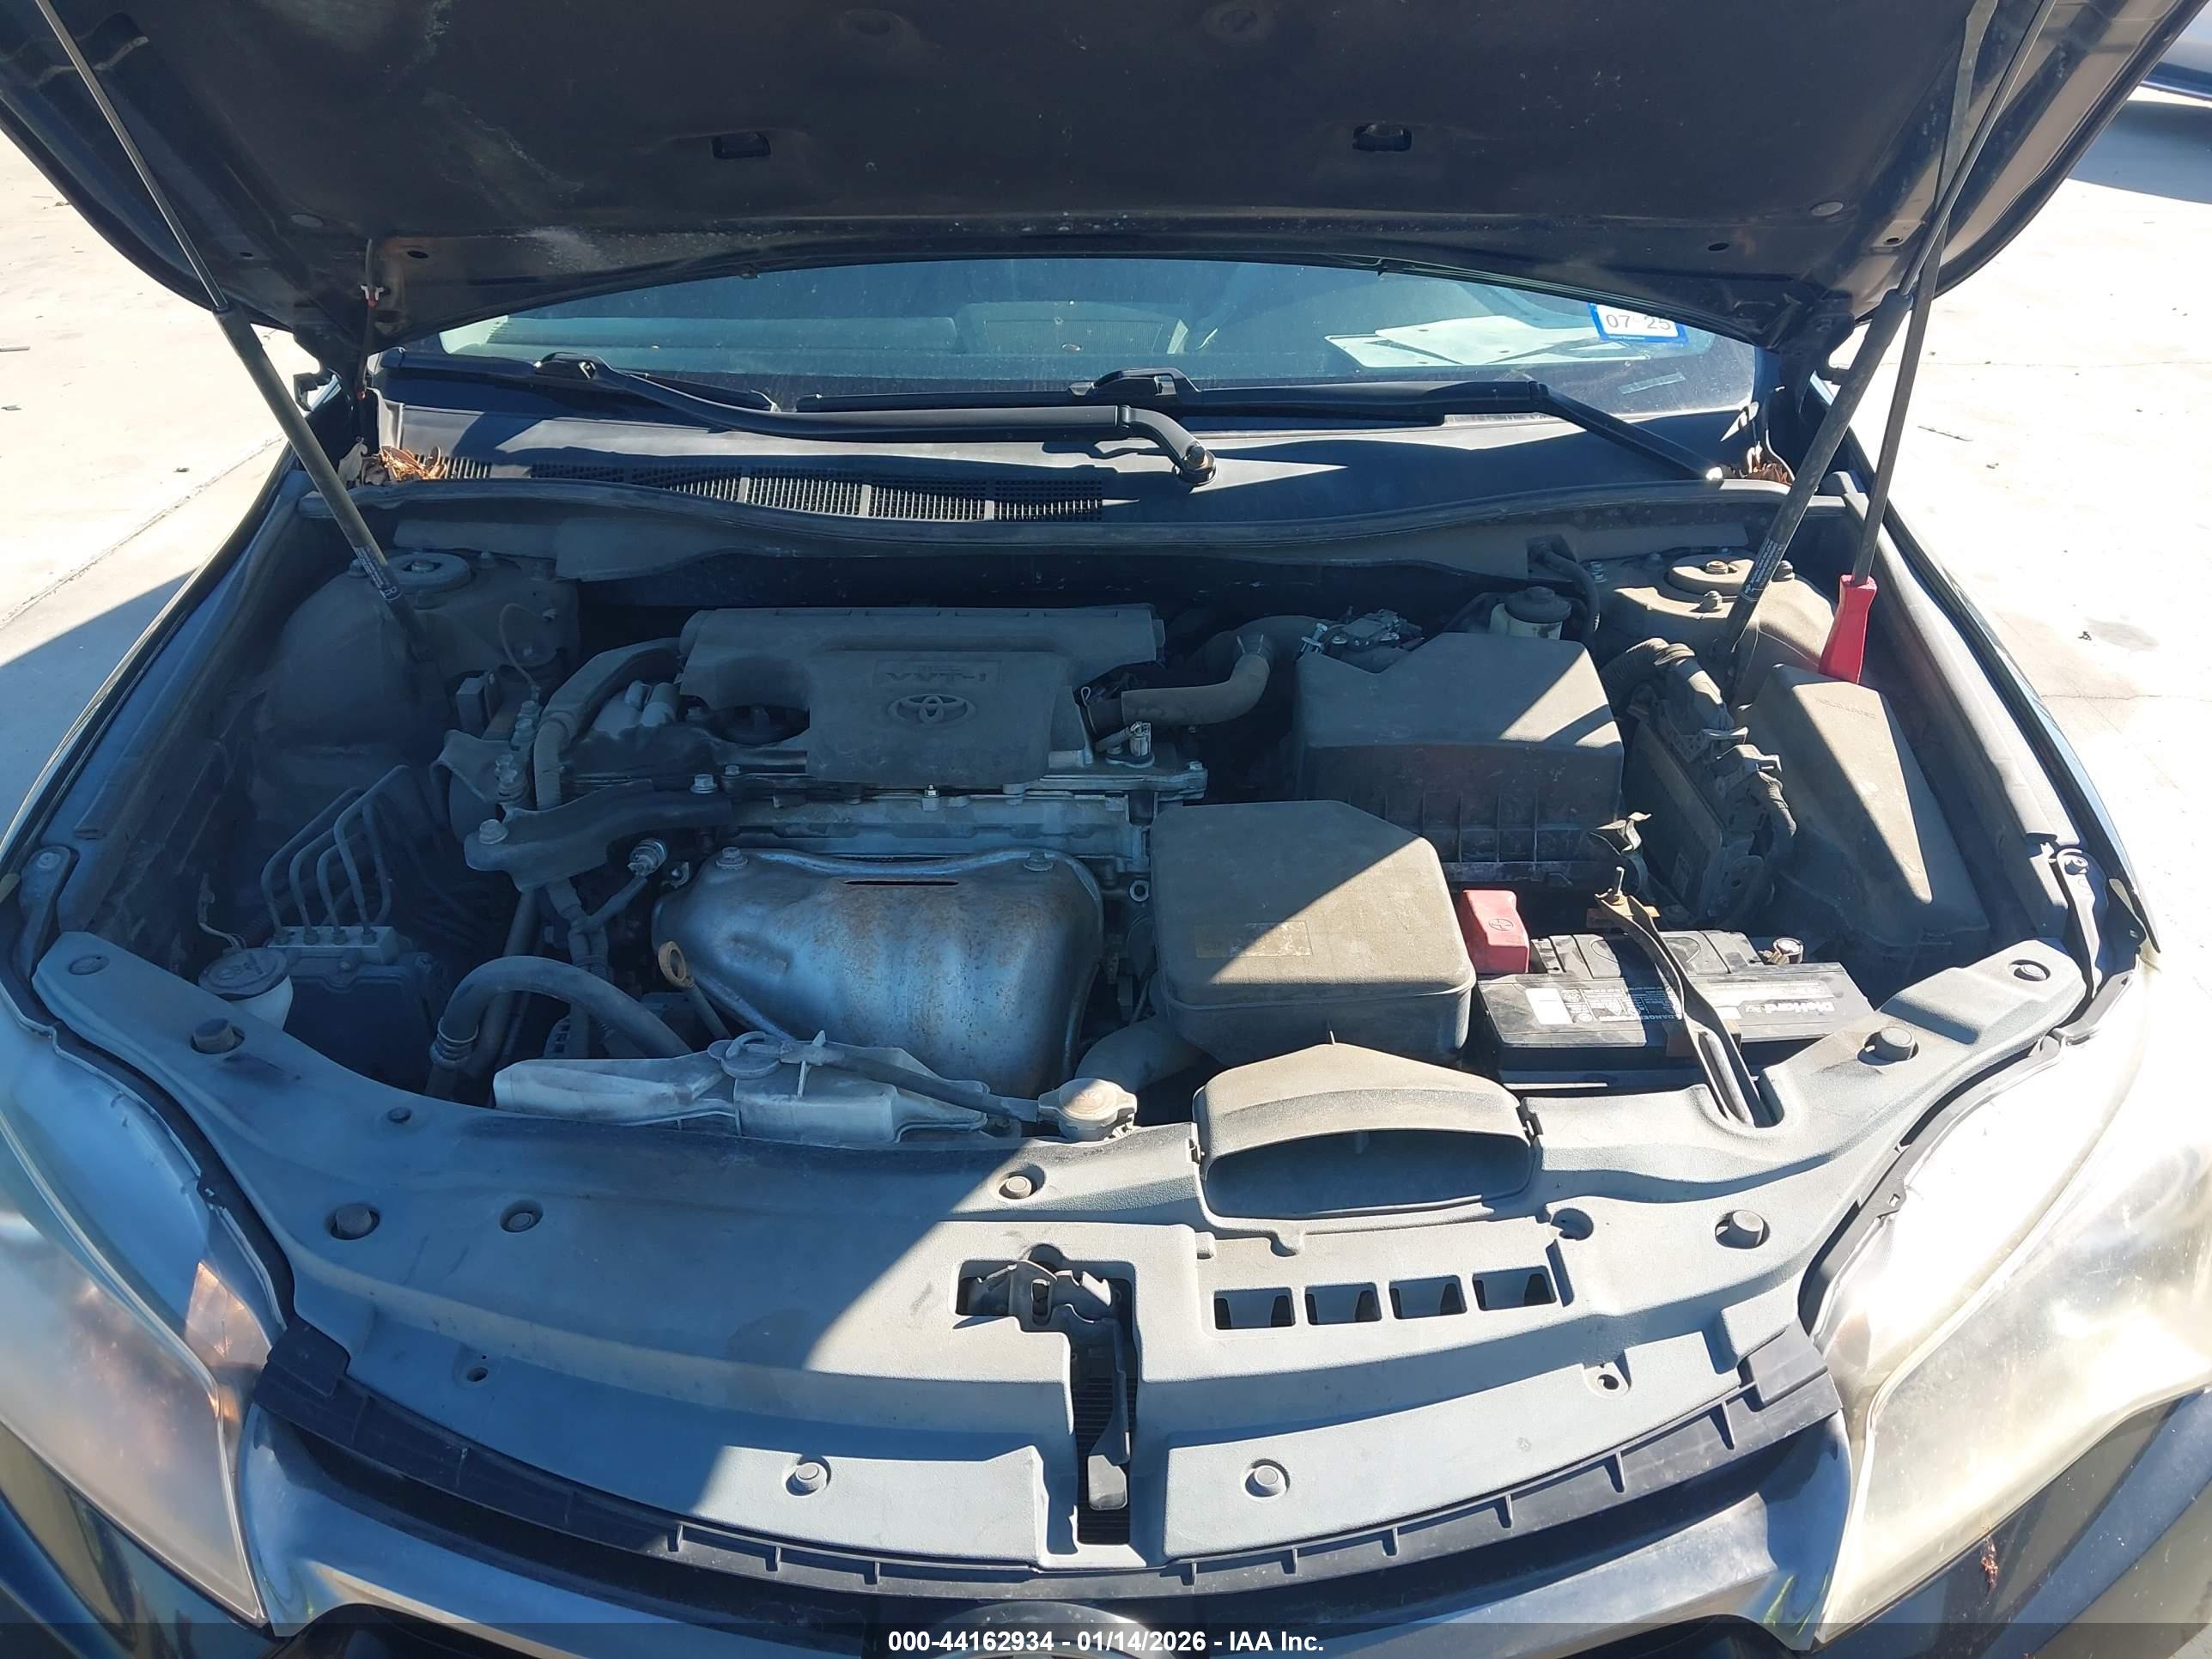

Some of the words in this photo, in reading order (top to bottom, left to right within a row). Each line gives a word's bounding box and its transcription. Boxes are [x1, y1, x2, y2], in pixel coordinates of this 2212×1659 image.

[1606, 314, 1631, 328] 07
[1644, 315, 1671, 330] 25
[1765, 1001, 1835, 1013] DieHard
